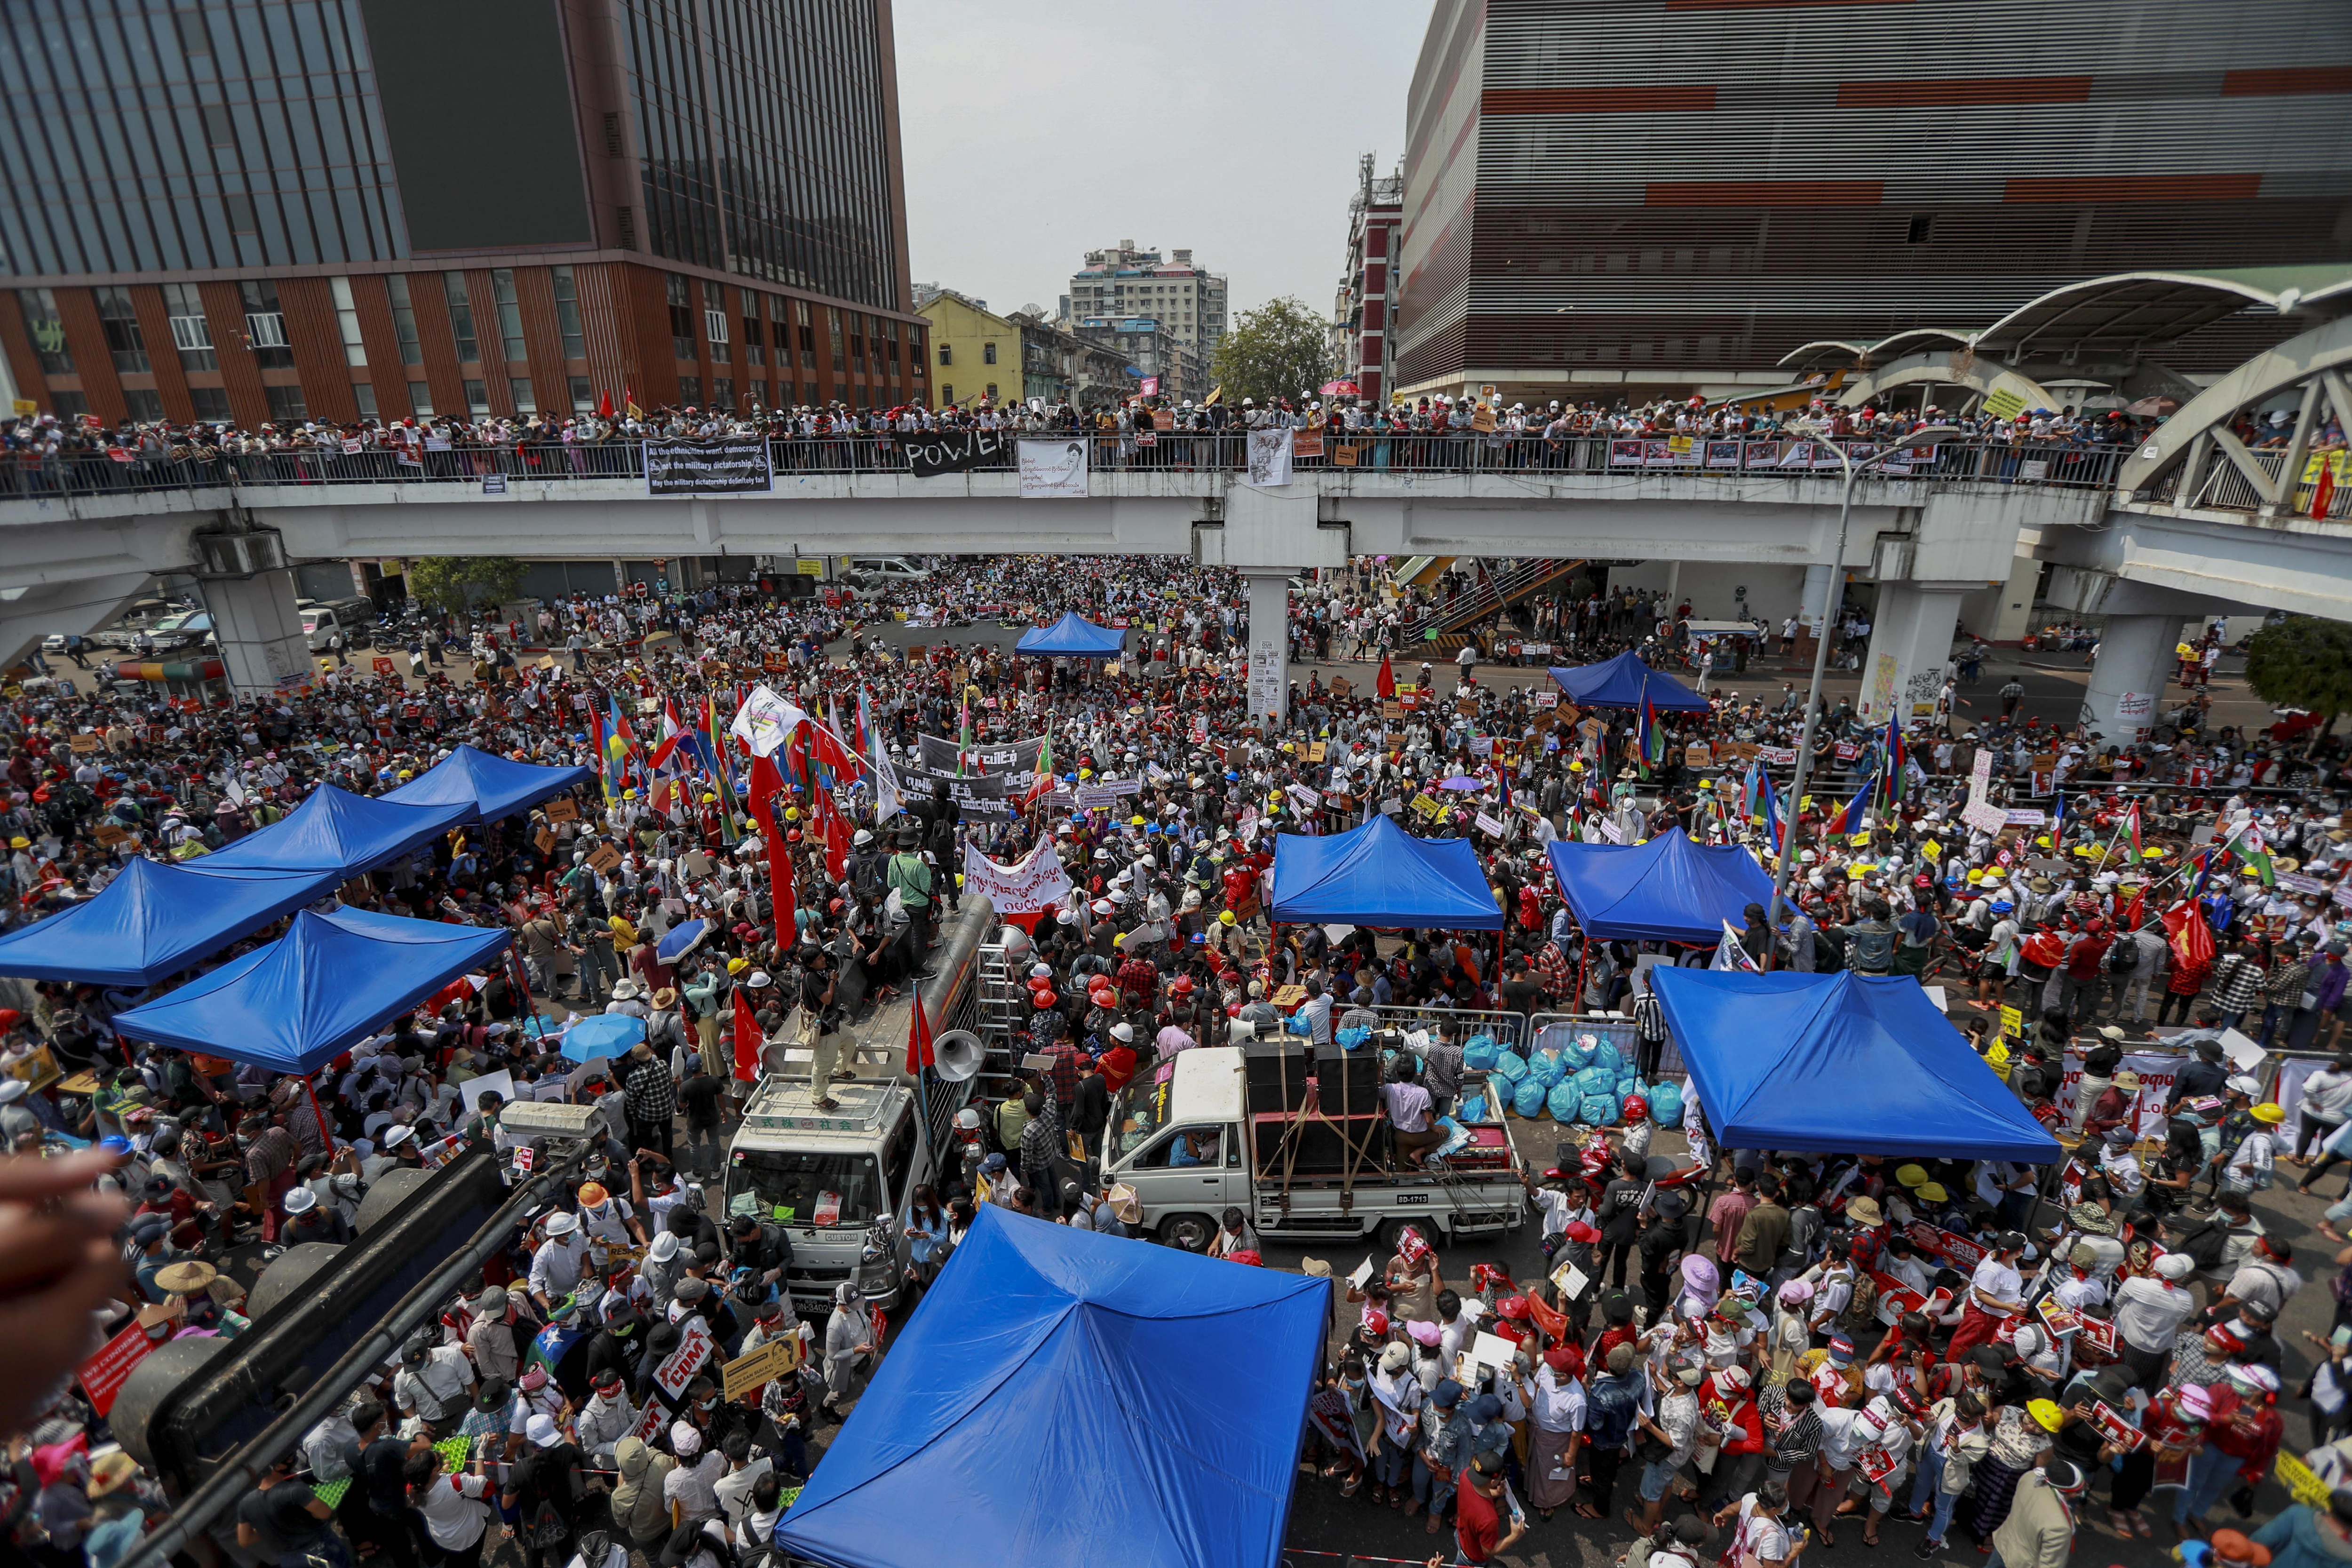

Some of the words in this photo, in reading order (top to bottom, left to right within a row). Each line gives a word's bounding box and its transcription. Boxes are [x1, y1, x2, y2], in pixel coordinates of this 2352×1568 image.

[670, 446, 704, 455] ethnicities
[724, 445, 762, 454] democracy,
[662, 461, 672, 470] not
[674, 461, 684, 470] the
[685, 460, 711, 471] military
[713, 460, 753, 470] dictatorship.
[695, 478, 727, 486] dictatorship
[1158, 1082, 1168, 1106] Audio
[1949, 1237, 1979, 1252] FREE
[1952, 1244, 1979, 1258] OUR
[796, 1303, 829, 1313] 9N-3402
[83, 1365, 100, 1378] WE
[99, 1330, 142, 1368] CONDEMN
[670, 1340, 705, 1387] CDM
[743, 1373, 754, 1383] SAN
